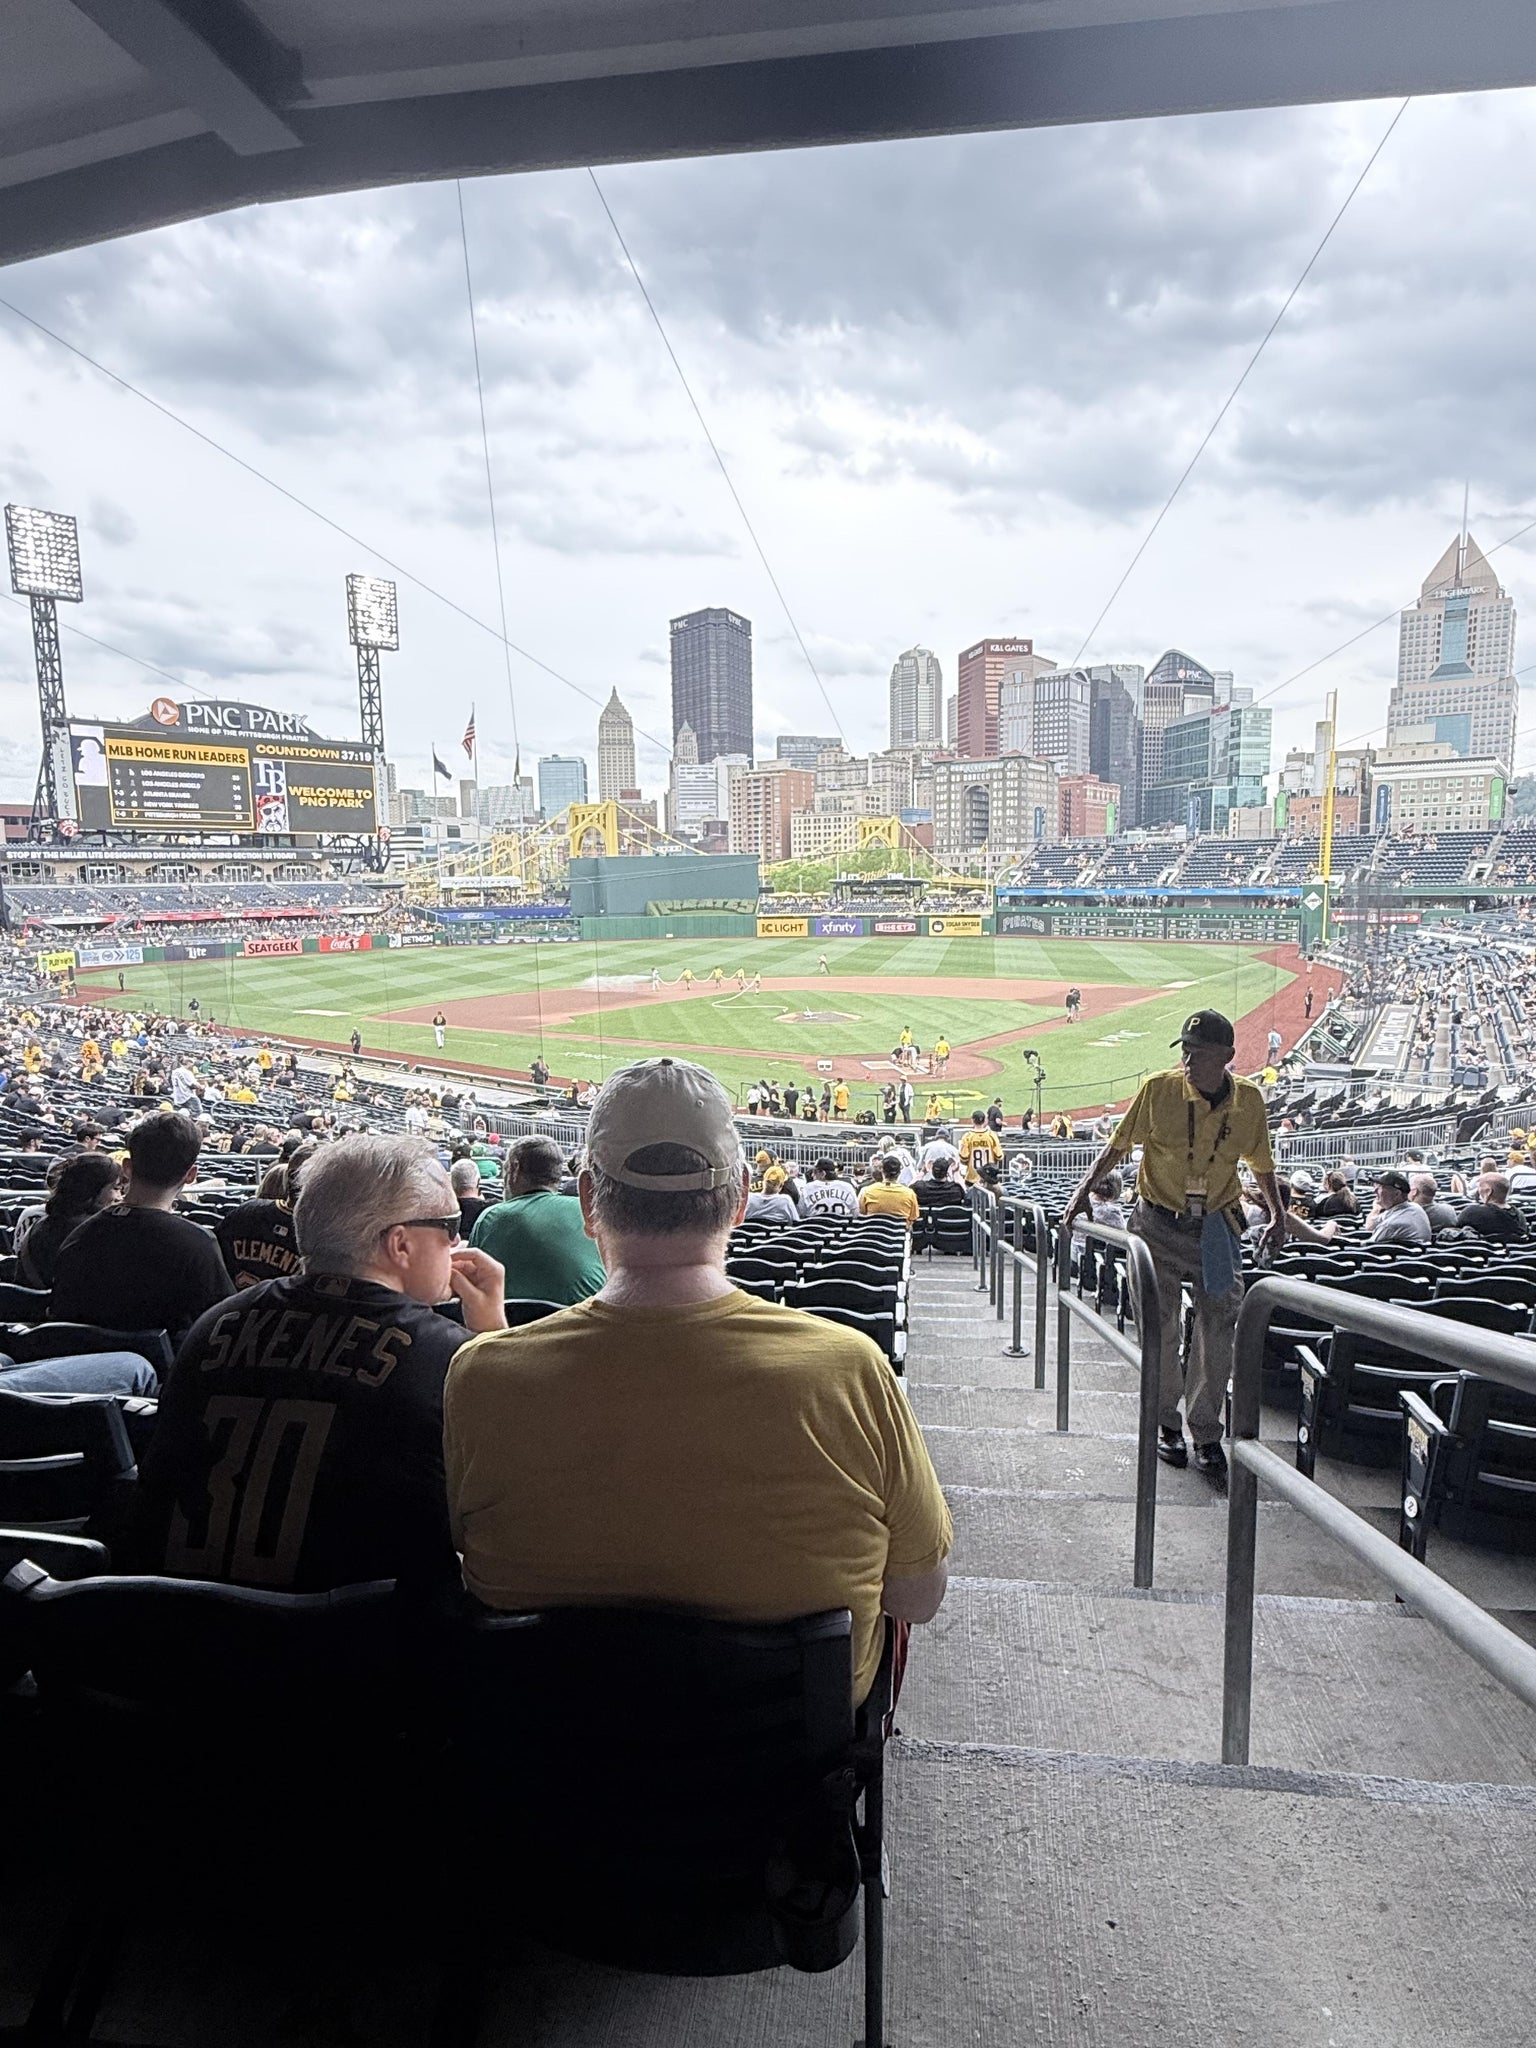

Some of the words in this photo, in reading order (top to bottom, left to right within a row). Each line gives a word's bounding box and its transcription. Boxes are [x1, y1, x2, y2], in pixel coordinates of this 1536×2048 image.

[1005, 644, 1028, 652] GATES
[1186, 669, 1202, 679] PNC
[183, 703, 242, 729] PNC
[246, 709, 309, 734] PARK
[188, 727, 210, 735] HOME
[238, 731, 280, 740] PITTSBURGH
[281, 734, 309, 742] PIRATES
[108, 745, 133, 756] MLB
[135, 747, 170, 759] HOME
[173, 749, 197, 760] RUN
[198, 751, 246, 764] LEADERS
[256, 744, 339, 759] COUNTDOWN
[341, 751, 372, 762] 37:19
[288, 786, 354, 798] WELCOME
[356, 789, 373, 800] TO
[329, 798, 365, 809] PARK
[6, 851, 30, 859] STOP
[31, 851, 41, 859] BY
[42, 851, 58, 859] THE
[153, 851, 180, 859] DRIVER
[762, 924, 773, 933] IC
[775, 924, 804, 932] LIGHT
[822, 922, 856, 934] xfinity
[1002, 914, 1045, 933] PIRATES
[402, 935, 433, 944] BETMGM
[125, 949, 141, 960] 125
[248, 941, 299, 954] SEATGEEK
[1188, 1017, 1200, 1031] P
[973, 1149, 989, 1169] 81
[810, 1189, 851, 1204] CERVELLI
[233, 1240, 302, 1275] CLEMENT
[201, 1309, 412, 1388] SKENES
[164, 1395, 337, 1583] 30
